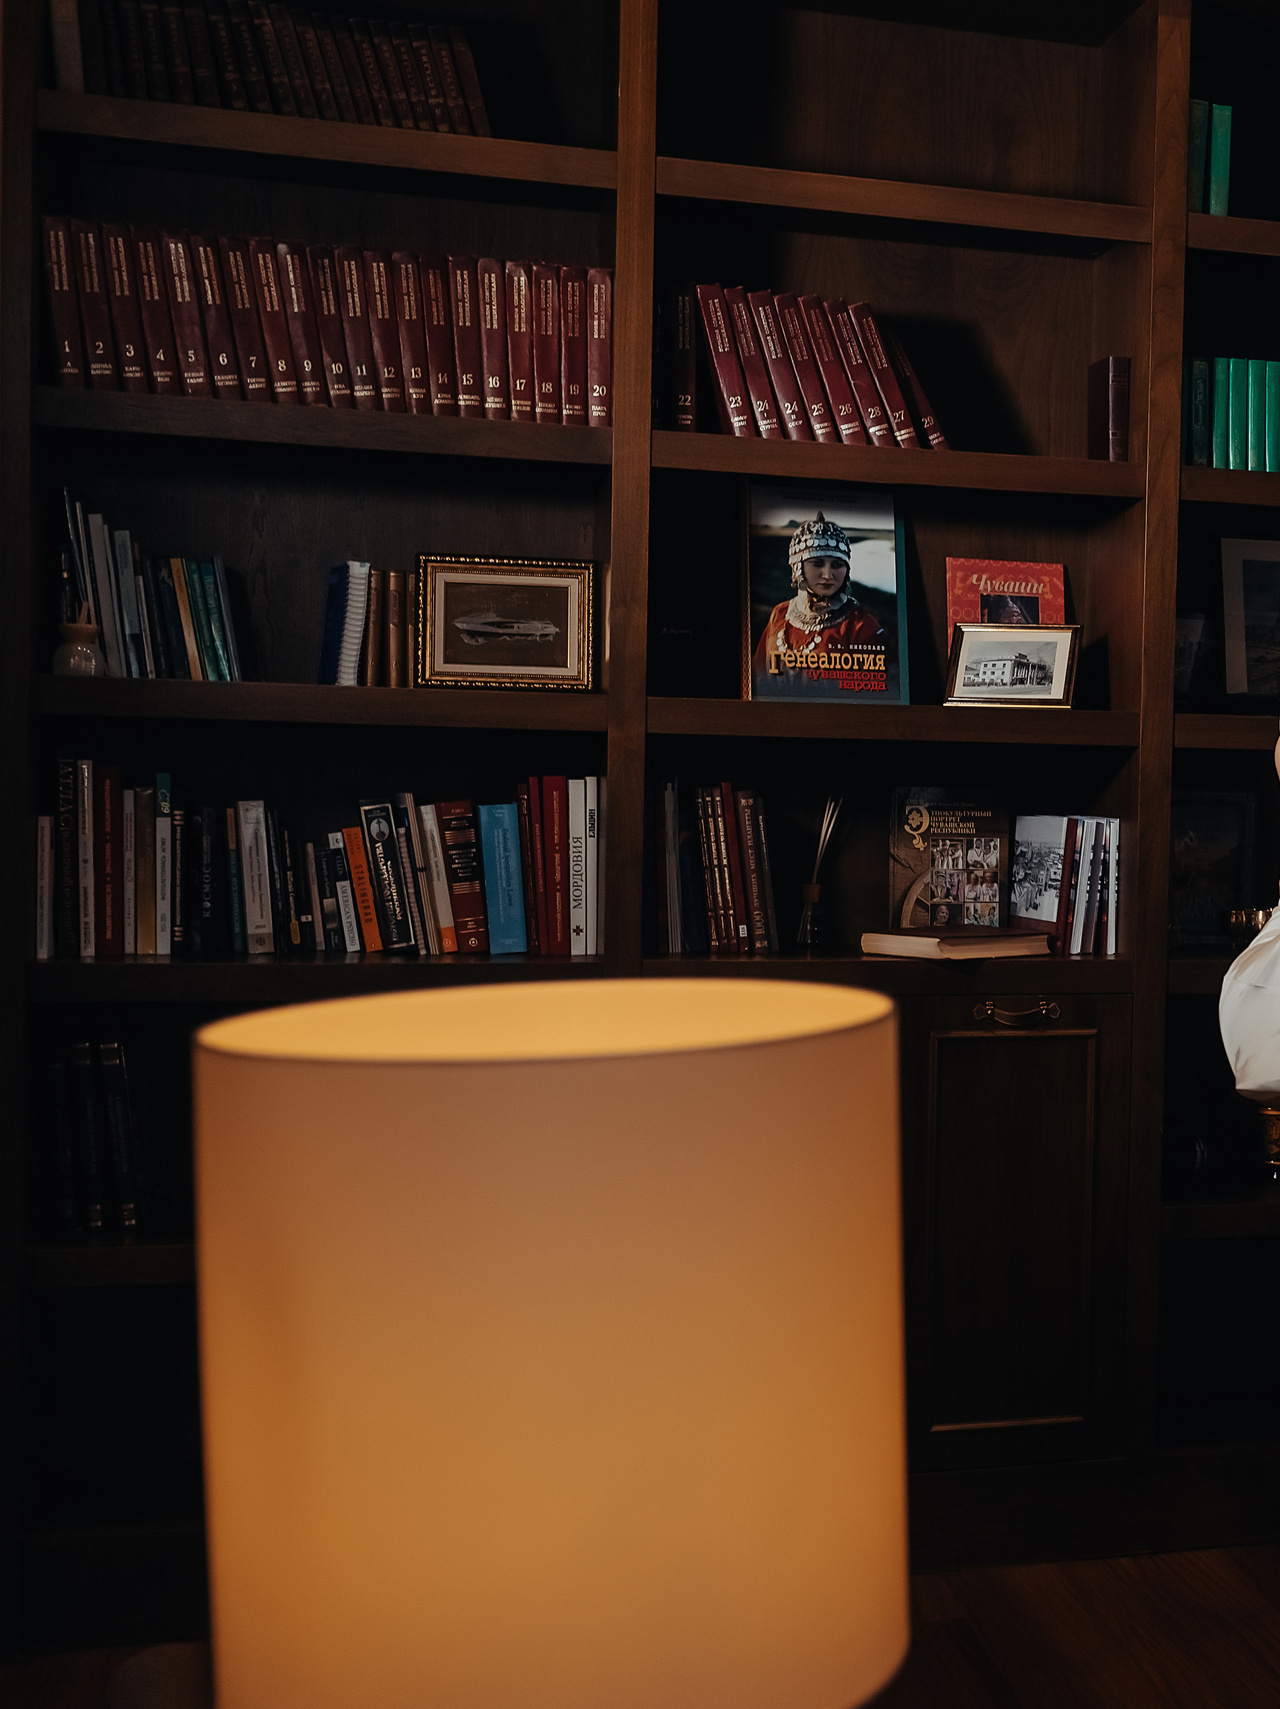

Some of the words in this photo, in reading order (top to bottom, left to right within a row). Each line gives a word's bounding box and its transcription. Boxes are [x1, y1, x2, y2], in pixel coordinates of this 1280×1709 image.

[64, 340, 70, 352] 1
[95, 342, 104, 354] 2
[126, 344, 134, 357] 3
[156, 349, 165, 361] 4
[188, 350, 195, 362] 5
[219, 353, 227, 365] 6
[249, 357, 256, 368] 7
[278, 360, 286, 371] 8
[304, 360, 312, 371] 9
[332, 363, 343, 374] 10
[356, 364, 366, 376] 11
[384, 367, 395, 378] 12
[411, 367, 421, 378] 13
[438, 373, 448, 384] 14
[462, 374, 473, 385] 15
[488, 376, 500, 388] 16
[516, 379, 526, 390] 17
[542, 382, 553, 393] 18
[570, 384, 579, 395] 19
[593, 385, 606, 397] 20
[678, 395, 692, 406] 22
[729, 396, 743, 408] 23
[757, 401, 770, 412] 24
[785, 402, 799, 413] 24
[812, 403, 824, 415] 25
[839, 404, 852, 415] 26
[868, 406, 881, 418] 28
[893, 410, 905, 422] 27
[922, 417, 934, 428] 29
[972, 574, 1044, 595] Чуваши
[769, 650, 886, 674] Генеалогия
[805, 669, 886, 681] чувашского
[840, 681, 886, 692] народа
[60, 765, 73, 827] АТЛАС
[161, 803, 170, 814] 60
[744, 809, 754, 845] ПЛАНЕТЫ
[748, 849, 756, 869] МЕСТ
[572, 836, 583, 909] МОРДОВИЯ
[202, 866, 212, 917] КОСМОС
[354, 865, 373, 923] STALINGRAD
[339, 885, 352, 920] AMERICAN
[753, 910, 765, 935] 1000
[345, 921, 357, 947] PSYCHO
